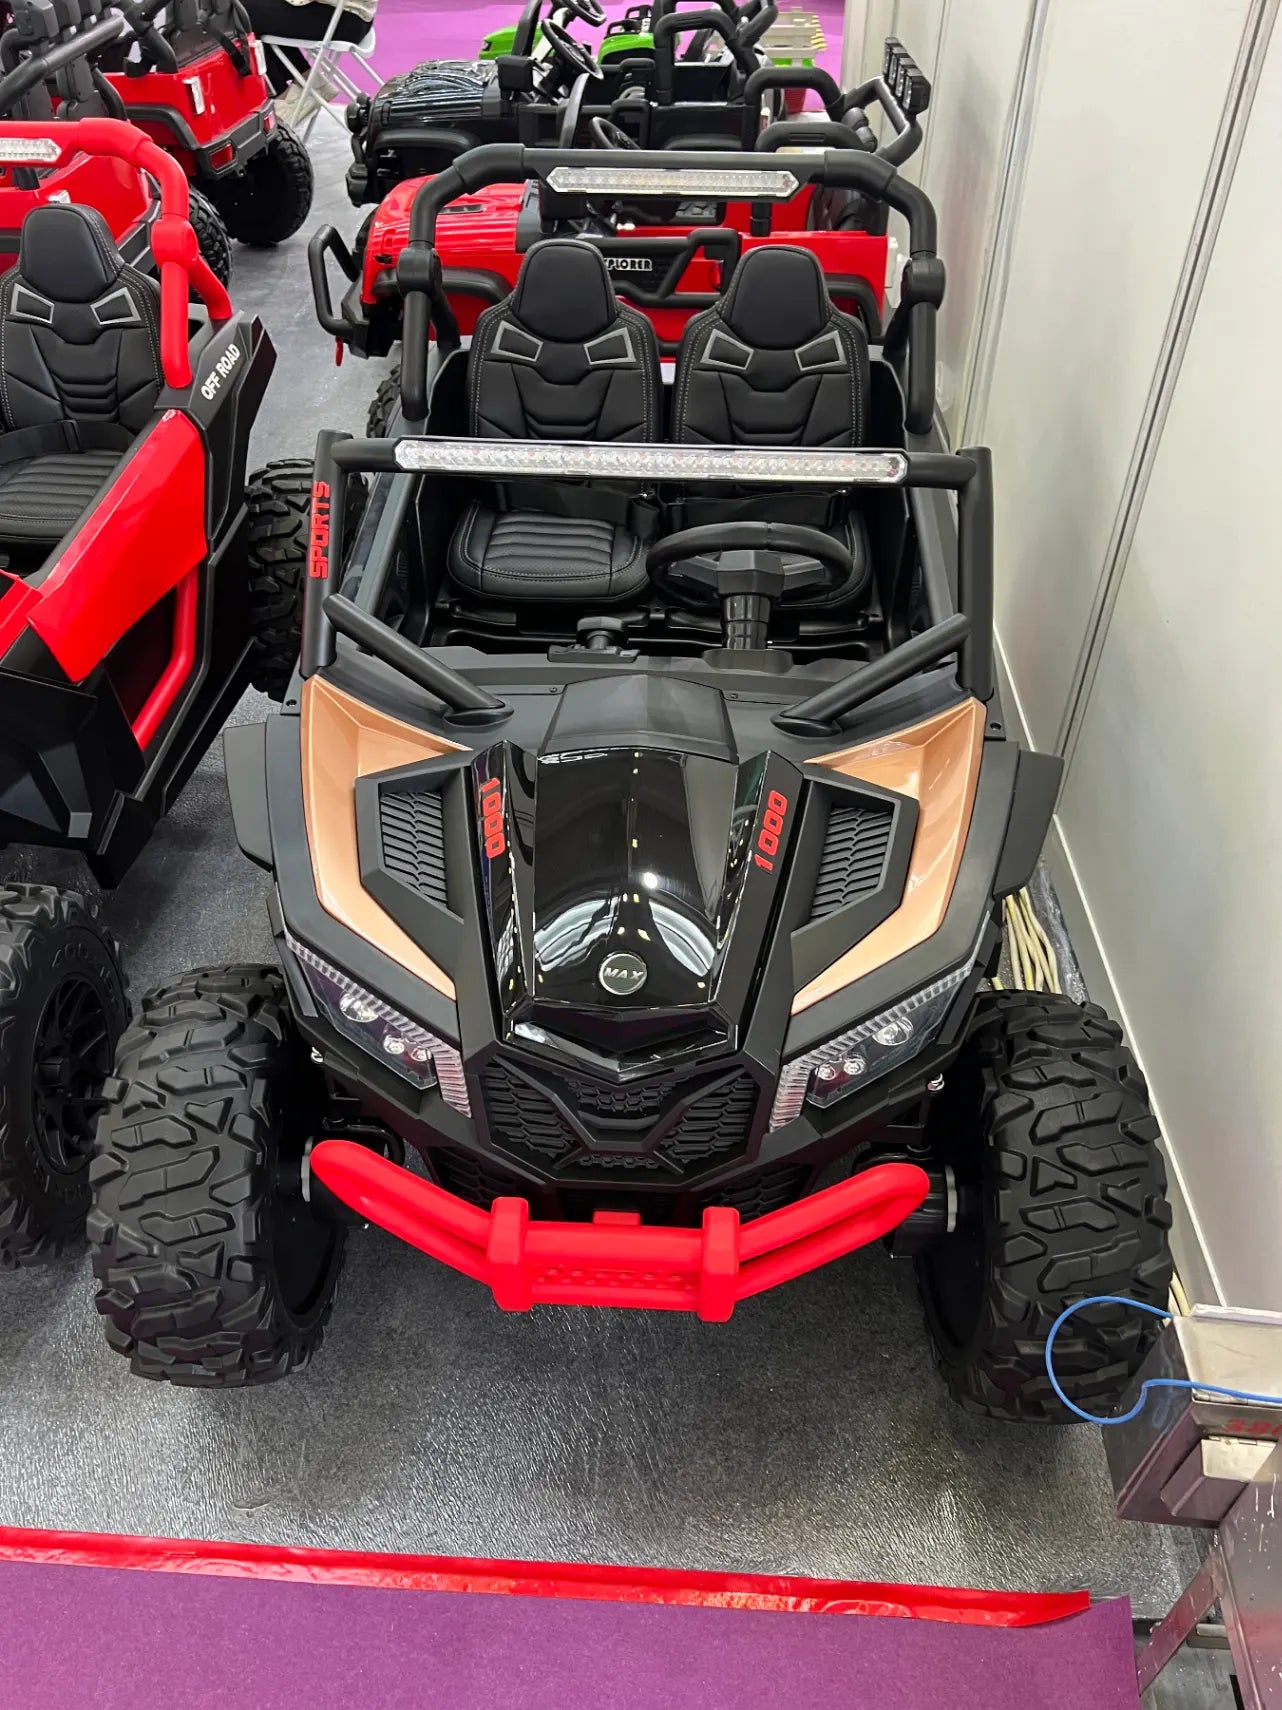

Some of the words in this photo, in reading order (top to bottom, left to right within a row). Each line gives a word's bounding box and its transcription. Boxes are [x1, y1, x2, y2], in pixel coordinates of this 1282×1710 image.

[201, 371, 220, 400] OFF
[216, 344, 240, 378] ROAD
[310, 481, 330, 579] SPORTS
[481, 777, 506, 859] 1000
[754, 790, 788, 871] 1000
[604, 967, 644, 980] MAX
